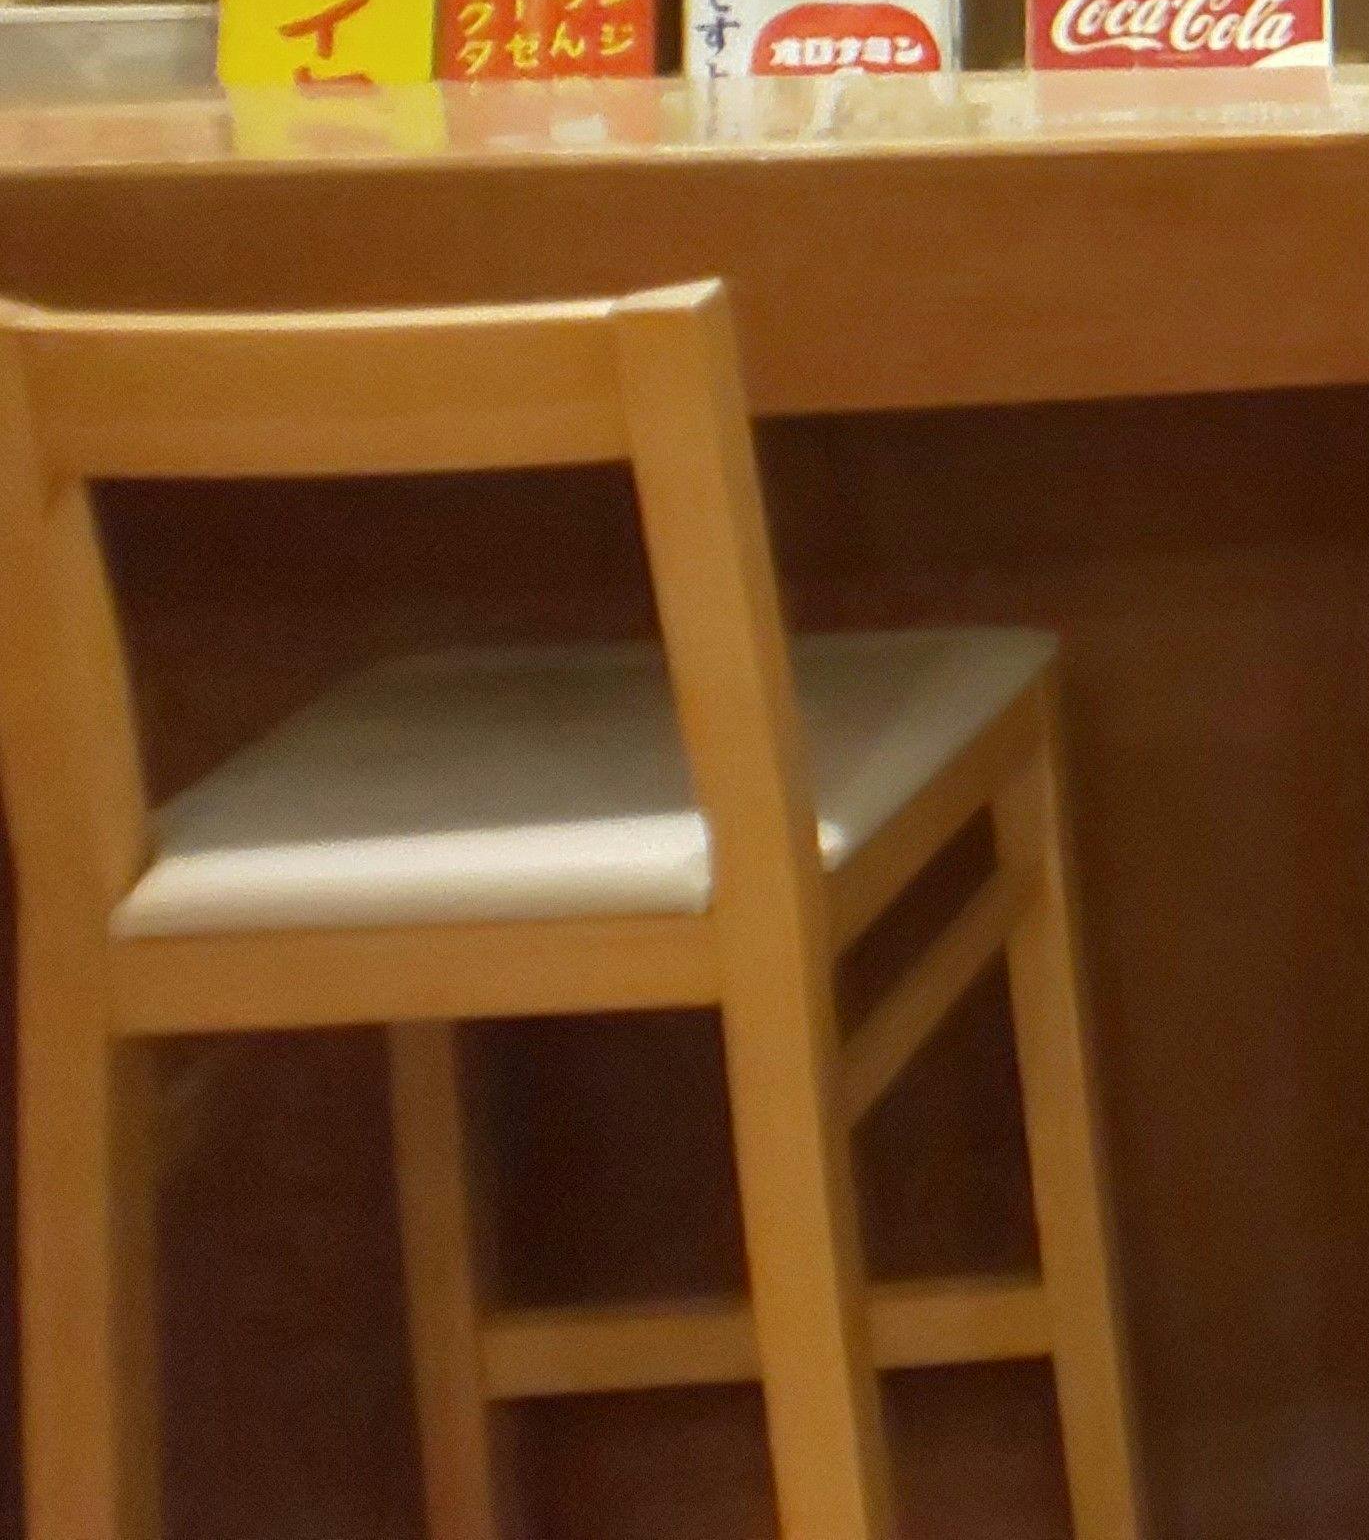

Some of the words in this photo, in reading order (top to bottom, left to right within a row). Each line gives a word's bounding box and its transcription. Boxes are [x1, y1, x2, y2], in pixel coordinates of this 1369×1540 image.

[770, 34, 925, 67] オロナミン
